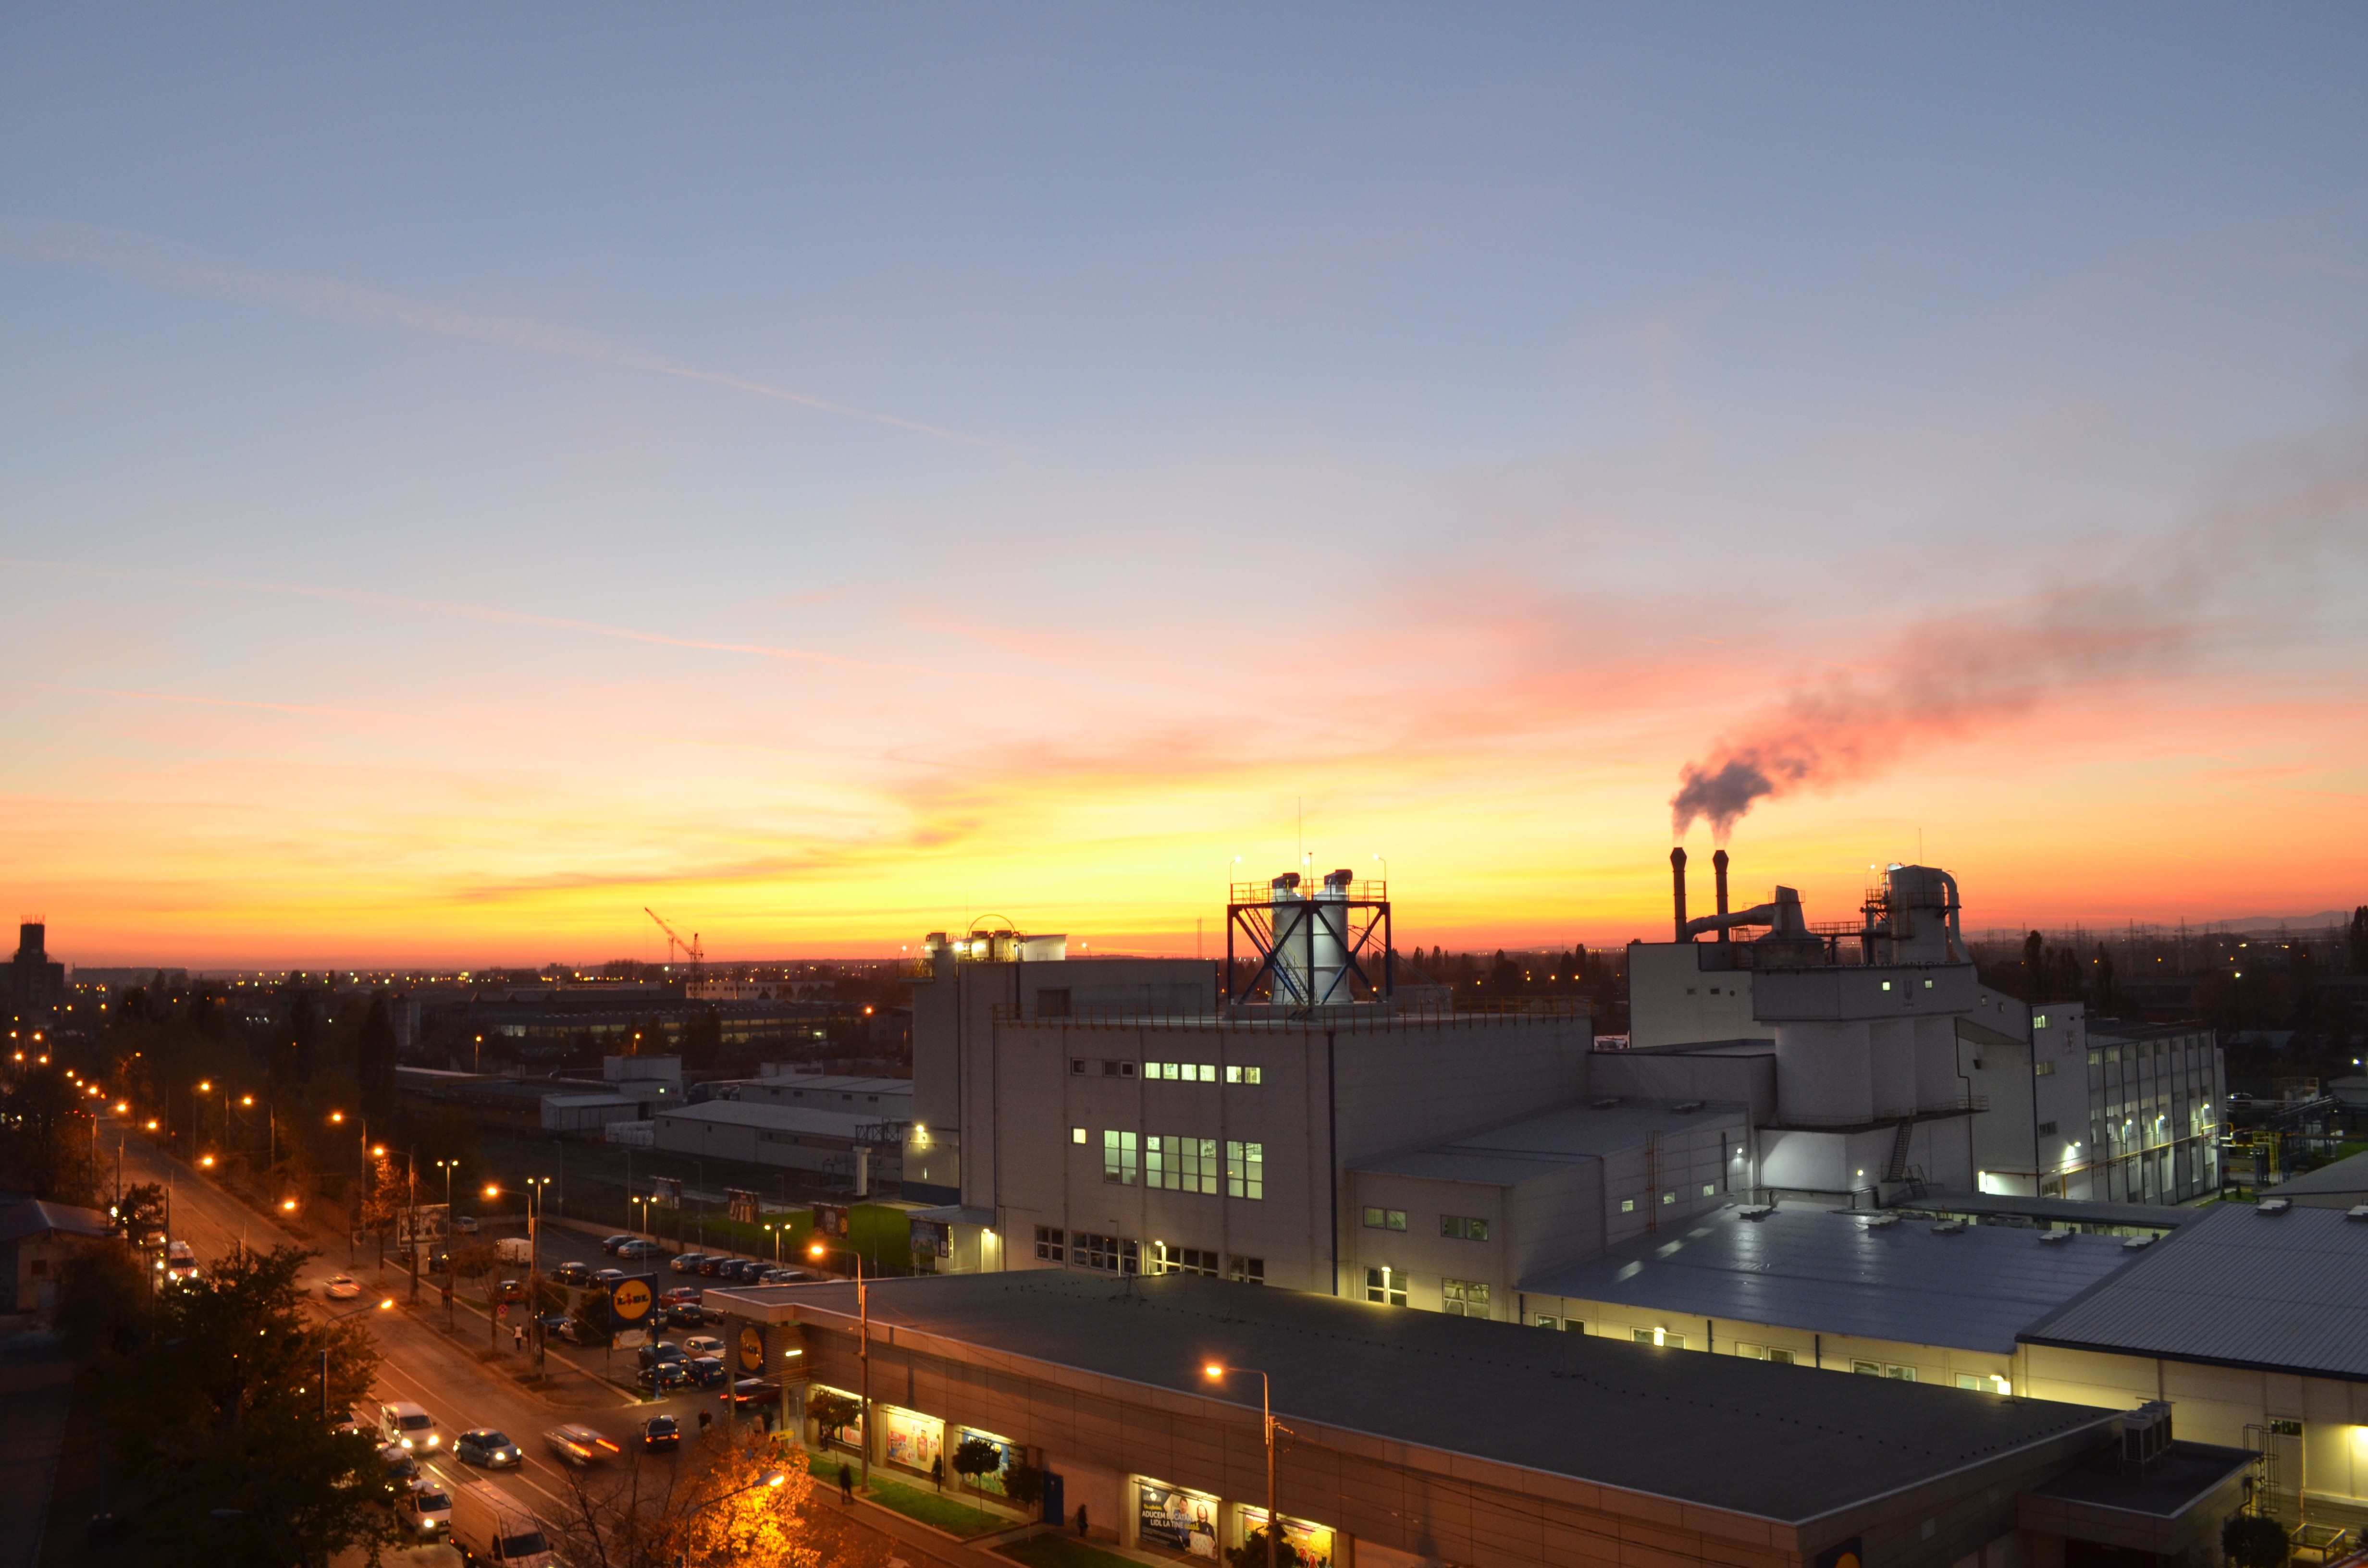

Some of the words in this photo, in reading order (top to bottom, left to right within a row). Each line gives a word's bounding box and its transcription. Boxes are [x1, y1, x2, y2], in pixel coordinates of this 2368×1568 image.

[617, 1294, 649, 1305] LIDL
[1142, 1510, 1166, 1519] ADUCEM
[1171, 1521, 1184, 1529] TINE
